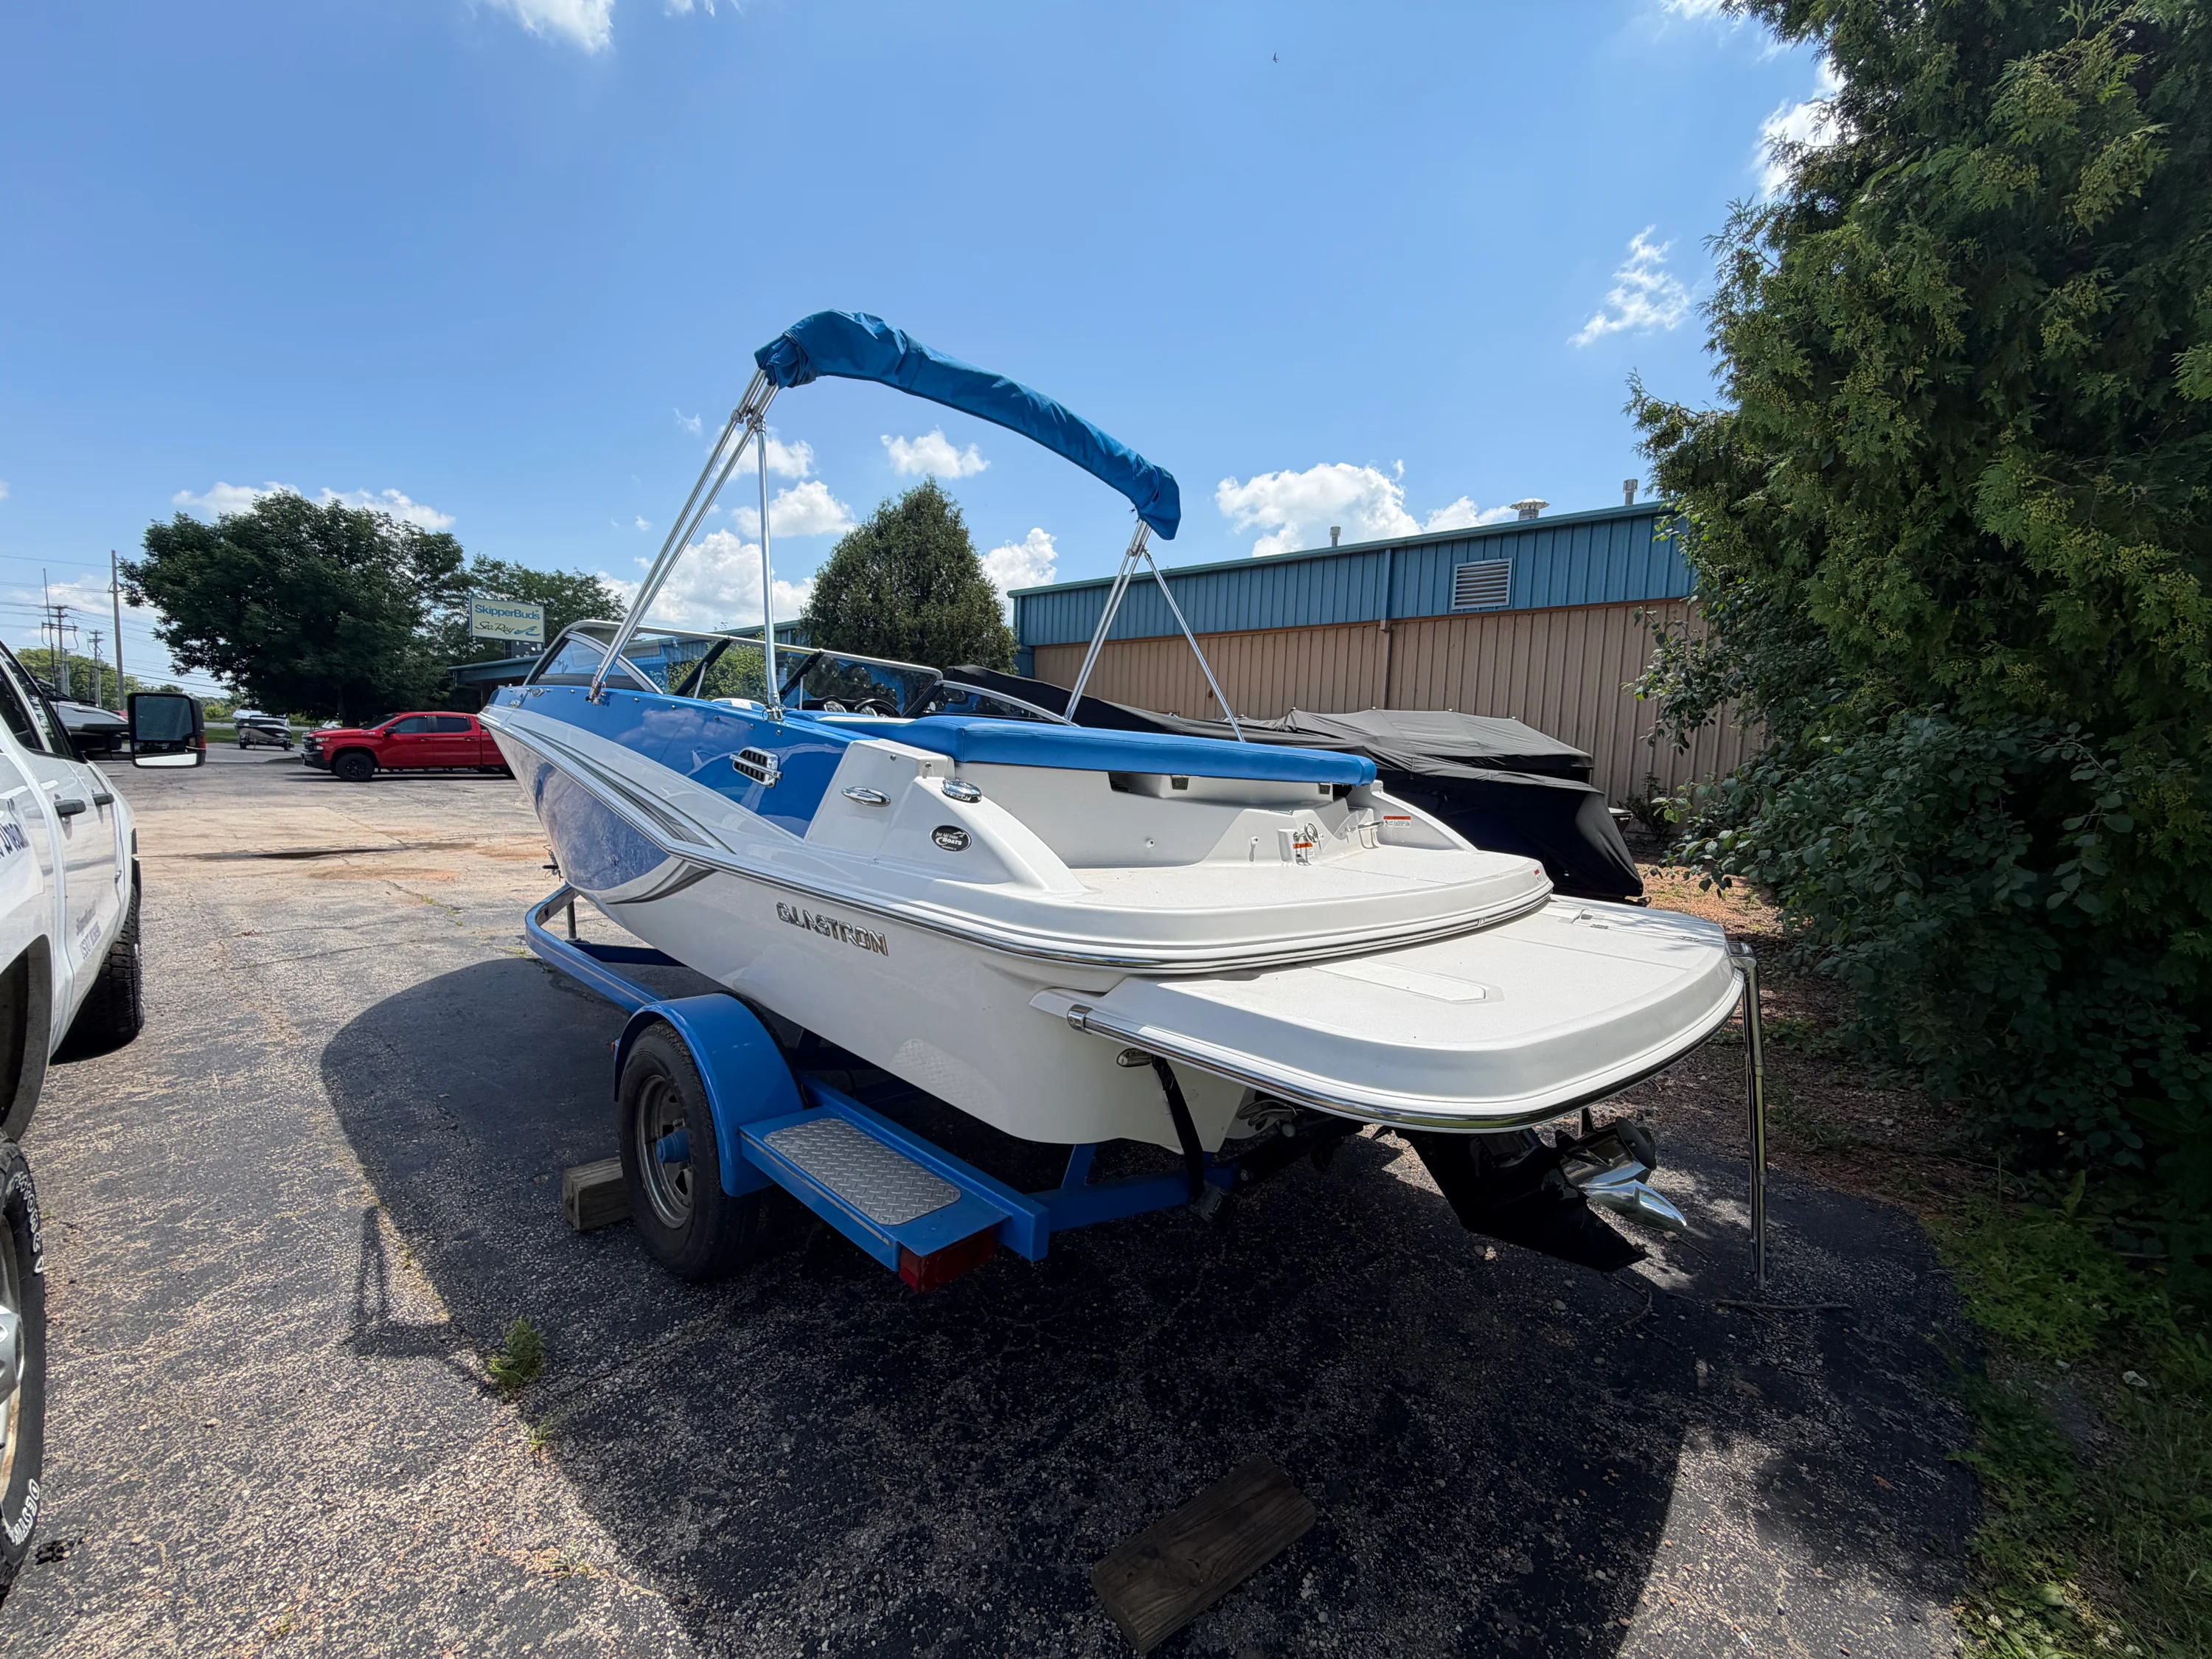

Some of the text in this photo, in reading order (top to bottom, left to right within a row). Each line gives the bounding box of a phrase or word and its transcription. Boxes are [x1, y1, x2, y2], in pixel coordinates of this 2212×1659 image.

[475, 604, 540, 620] SkipperBud's
[475, 621, 515, 635] Sea Ray
[942, 837, 963, 846] BOATS
[776, 901, 889, 956] GLASTRON
